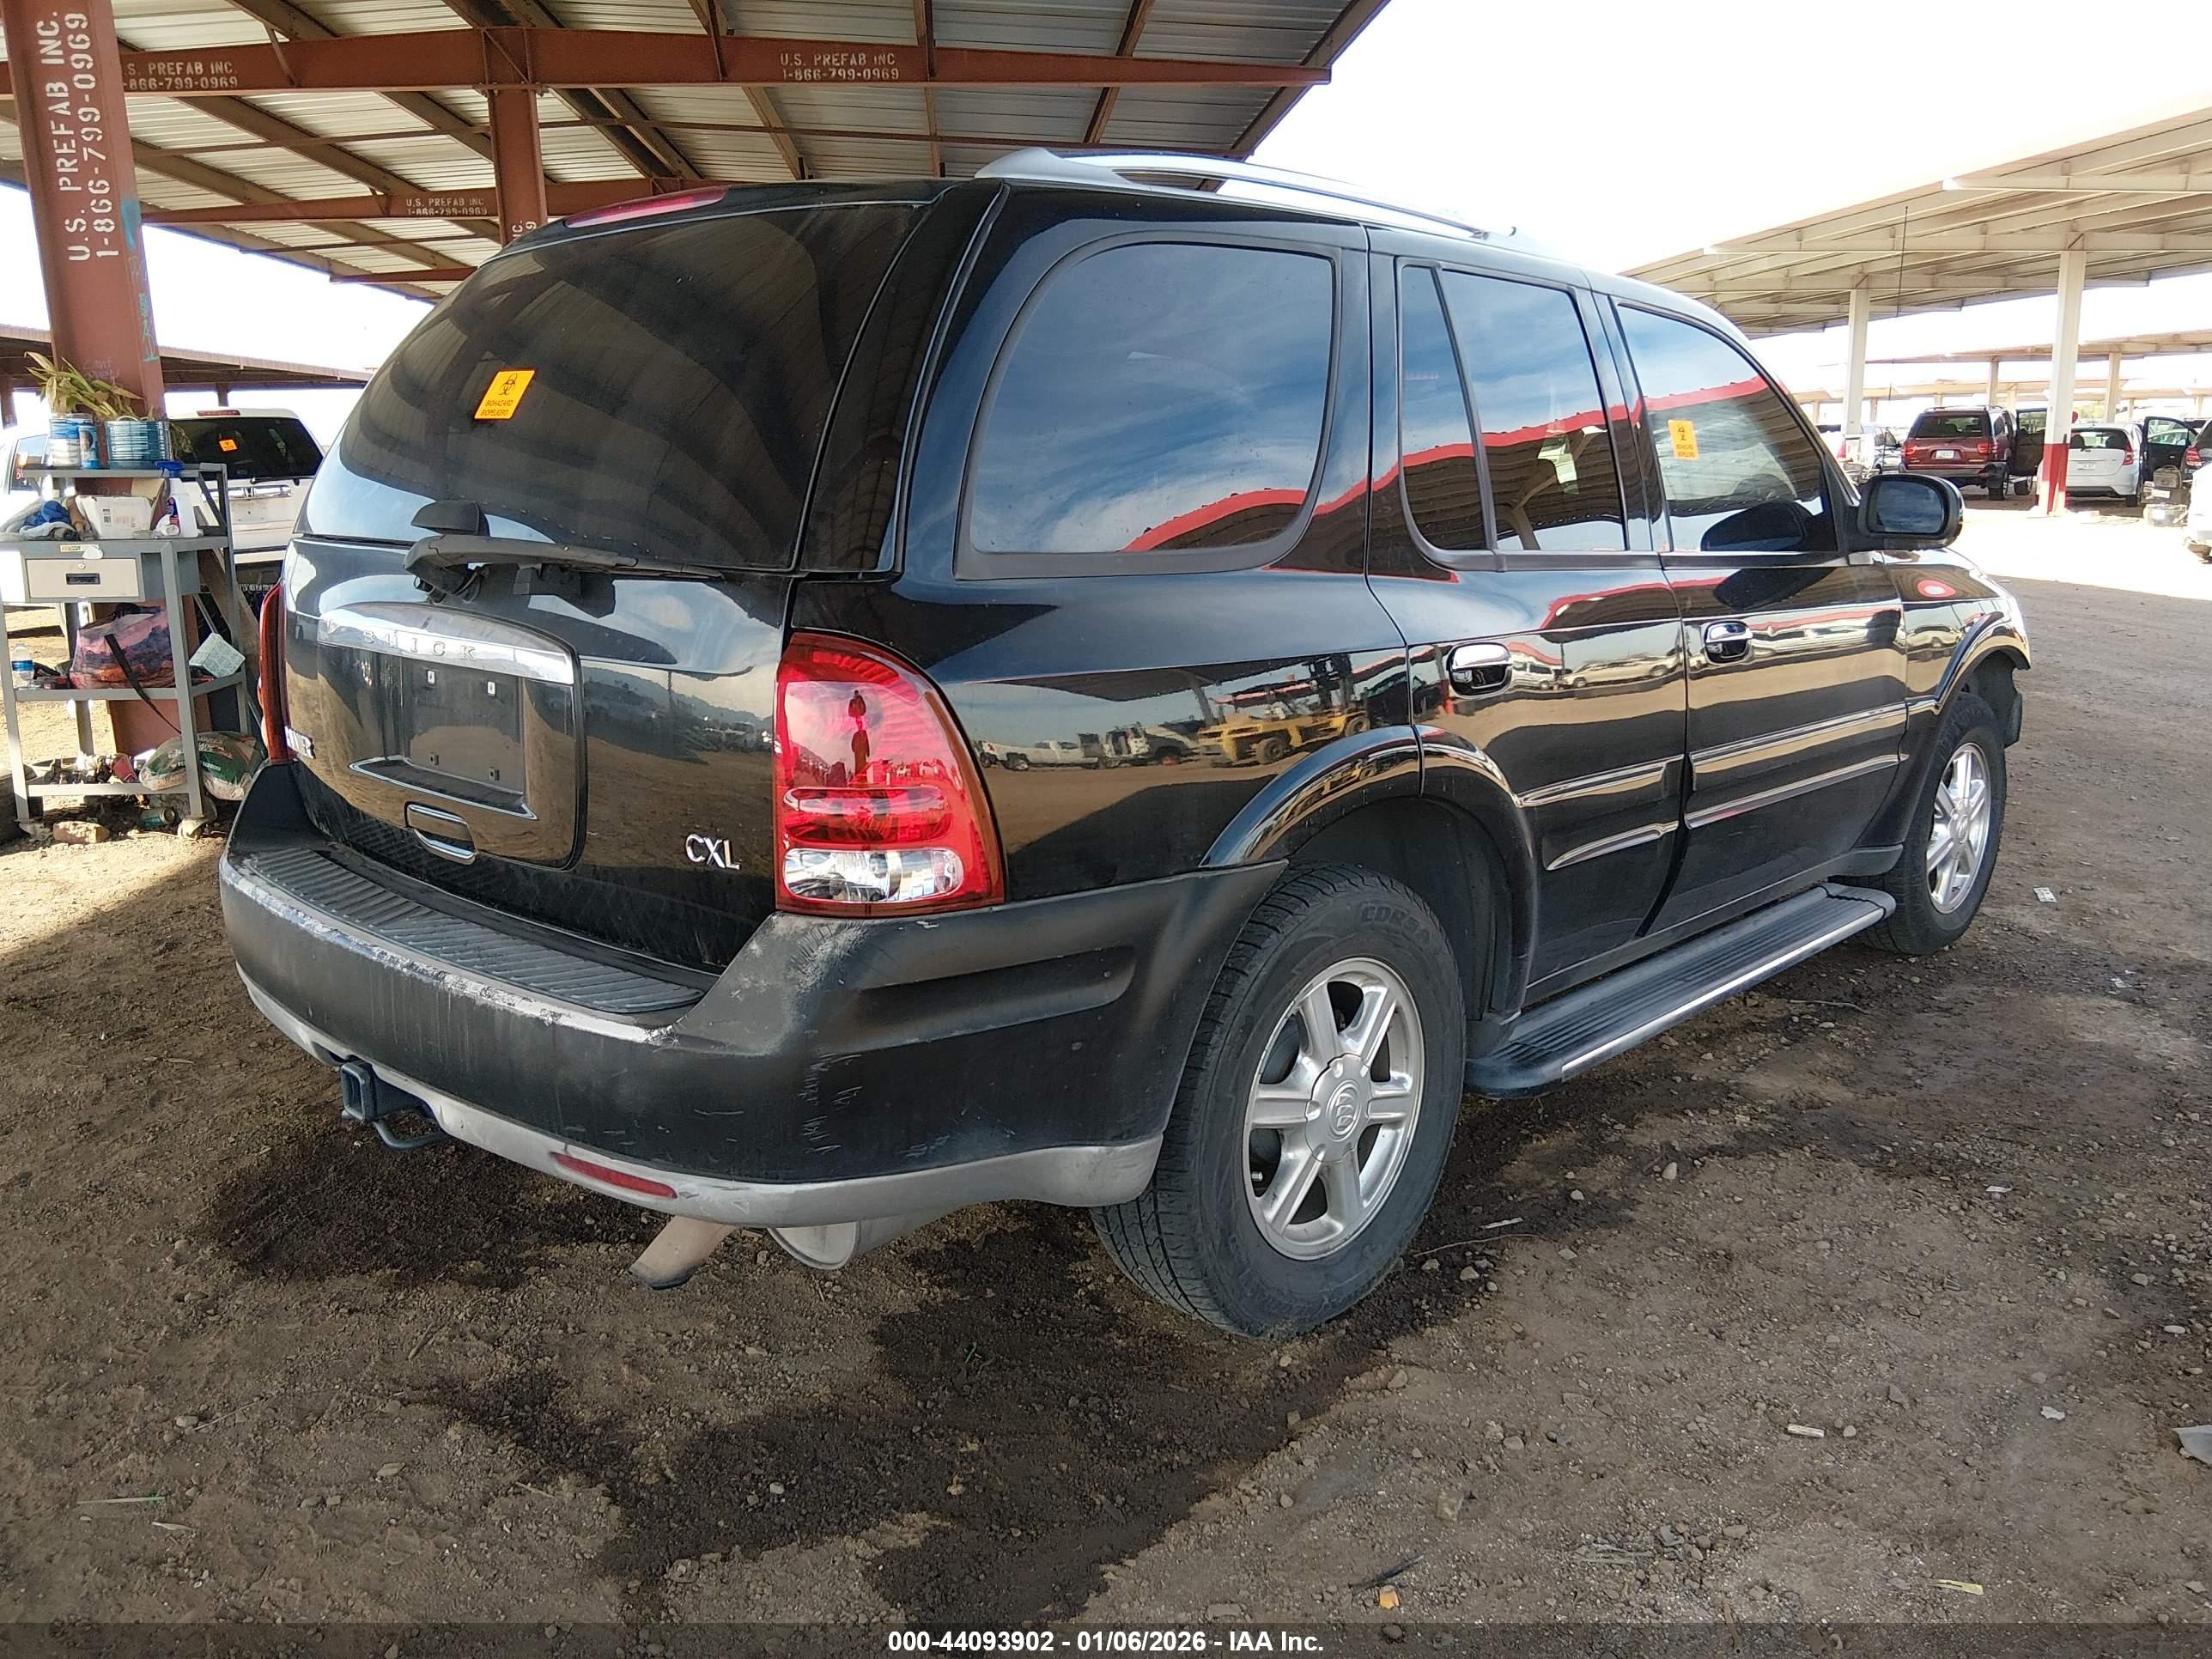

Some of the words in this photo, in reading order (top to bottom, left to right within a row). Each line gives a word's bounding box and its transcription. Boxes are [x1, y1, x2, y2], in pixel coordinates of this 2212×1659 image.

[36, 11, 65, 64] INC.
[148, 62, 204, 76] PREFAB
[780, 52, 806, 66] U.S.
[814, 52, 866, 67] PREFAB
[123, 76, 239, 91] -866-799-0969
[783, 68, 900, 82] 1-866-799-0969
[46, 82, 82, 191] PREFAB
[64, 13, 119, 258] 1-866-799-0969
[428, 198, 465, 207] PREFAB
[64, 209, 91, 261] U.S.
[363, 630, 476, 660] BUICK
[685, 833, 740, 871] CXL
